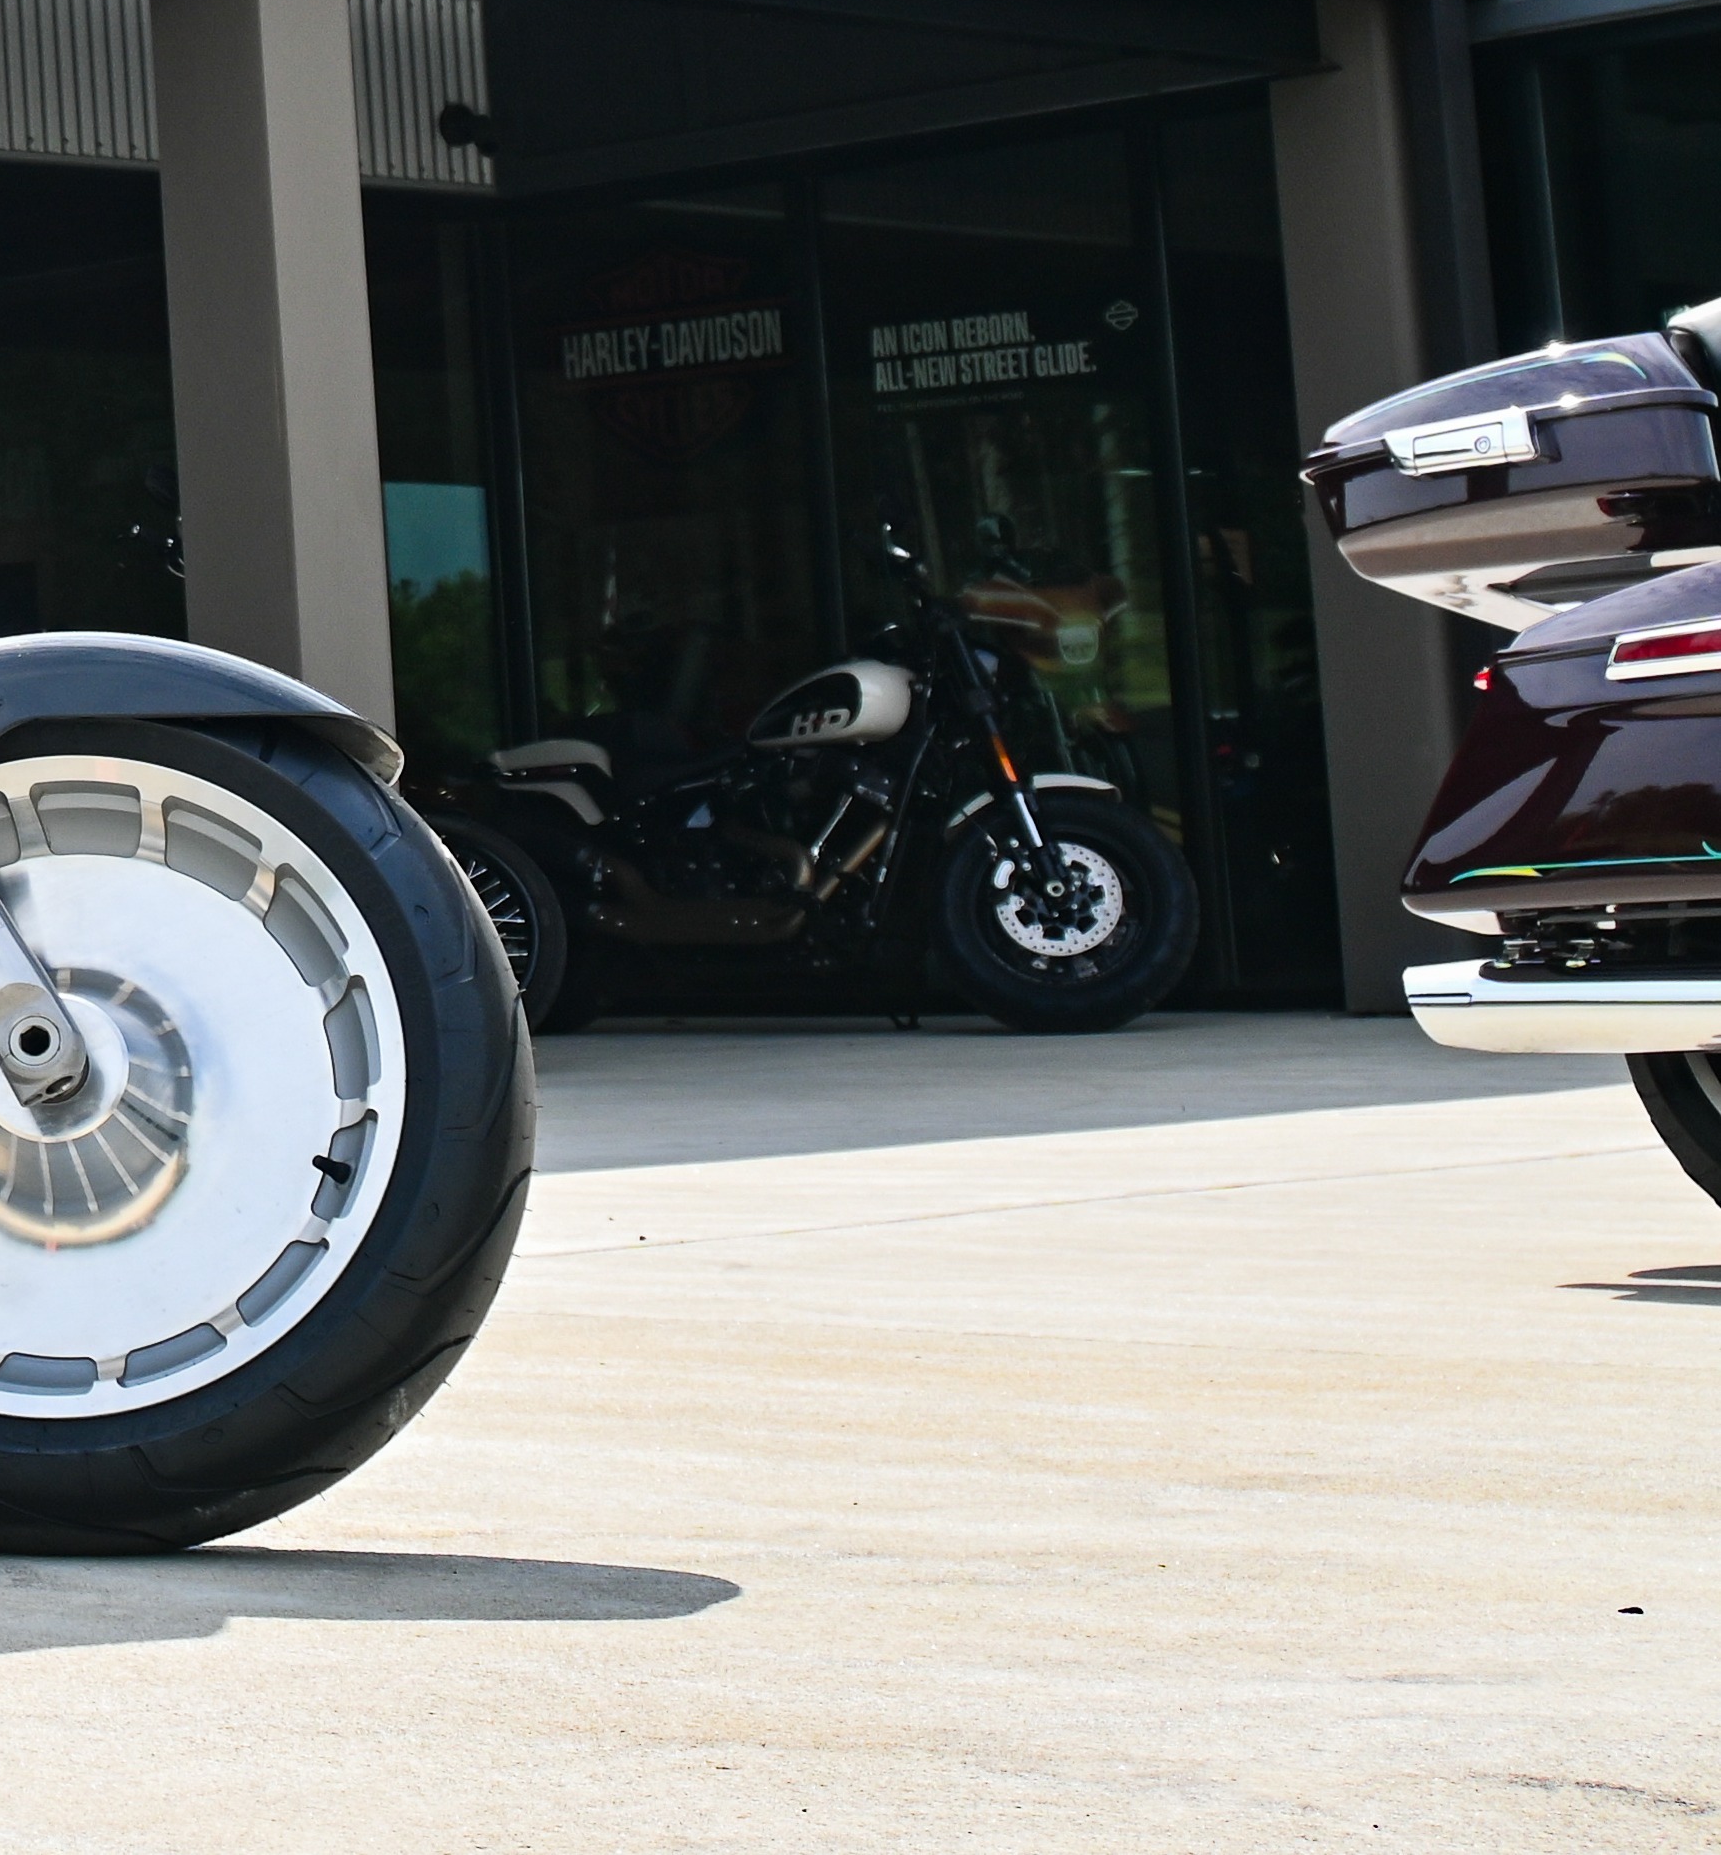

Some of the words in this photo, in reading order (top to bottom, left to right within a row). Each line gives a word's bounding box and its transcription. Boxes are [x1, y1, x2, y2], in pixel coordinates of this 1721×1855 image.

[563, 308, 782, 380] HARLEY-DAVIDSON
[872, 326, 899, 358] AN
[902, 321, 948, 353] ICON
[953, 311, 1036, 349] REBORN.
[875, 355, 957, 393] ALL-NEW
[959, 347, 1030, 385] STREET
[1034, 341, 1097, 378] GLIDE.
